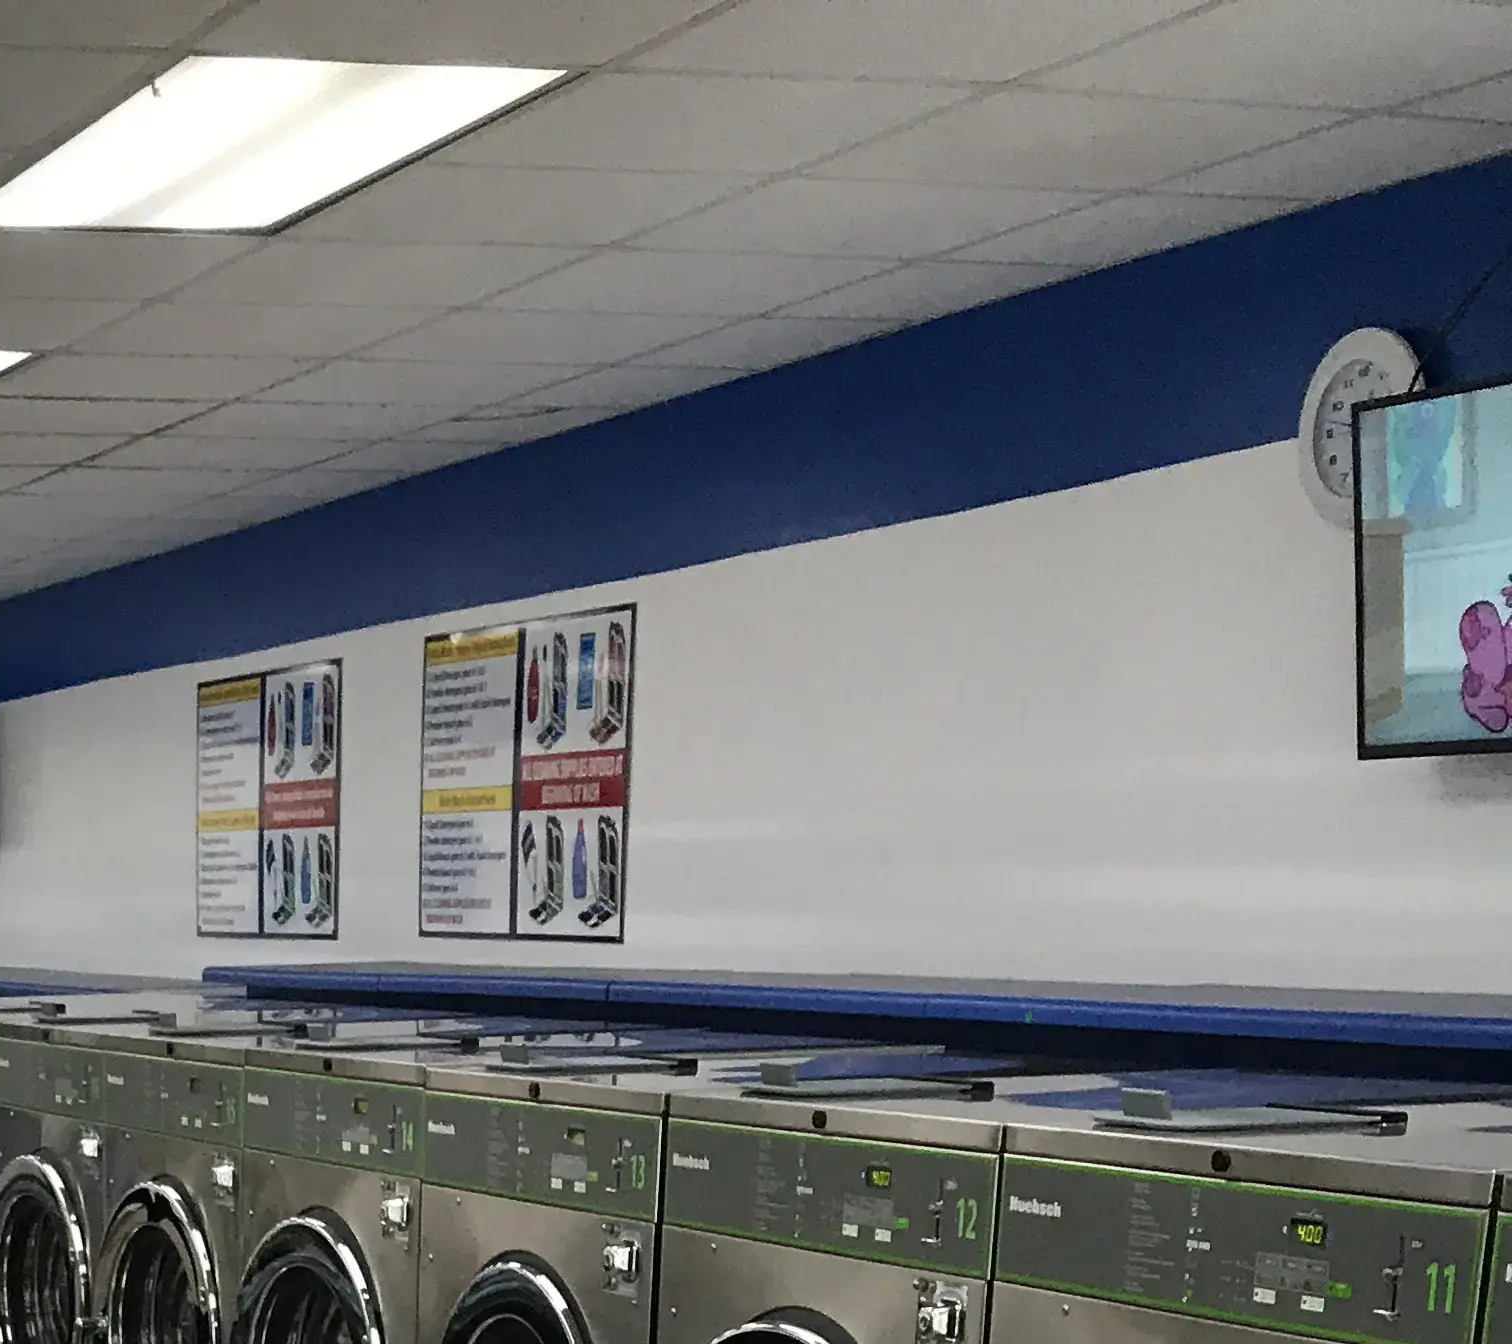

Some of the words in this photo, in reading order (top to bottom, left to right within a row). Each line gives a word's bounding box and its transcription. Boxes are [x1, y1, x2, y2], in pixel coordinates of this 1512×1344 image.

[630, 1154, 645, 1189] 13
[956, 1197, 979, 1240] 12
[1009, 1194, 1063, 1219] Huebsch
[1425, 1261, 1457, 1315] 11
